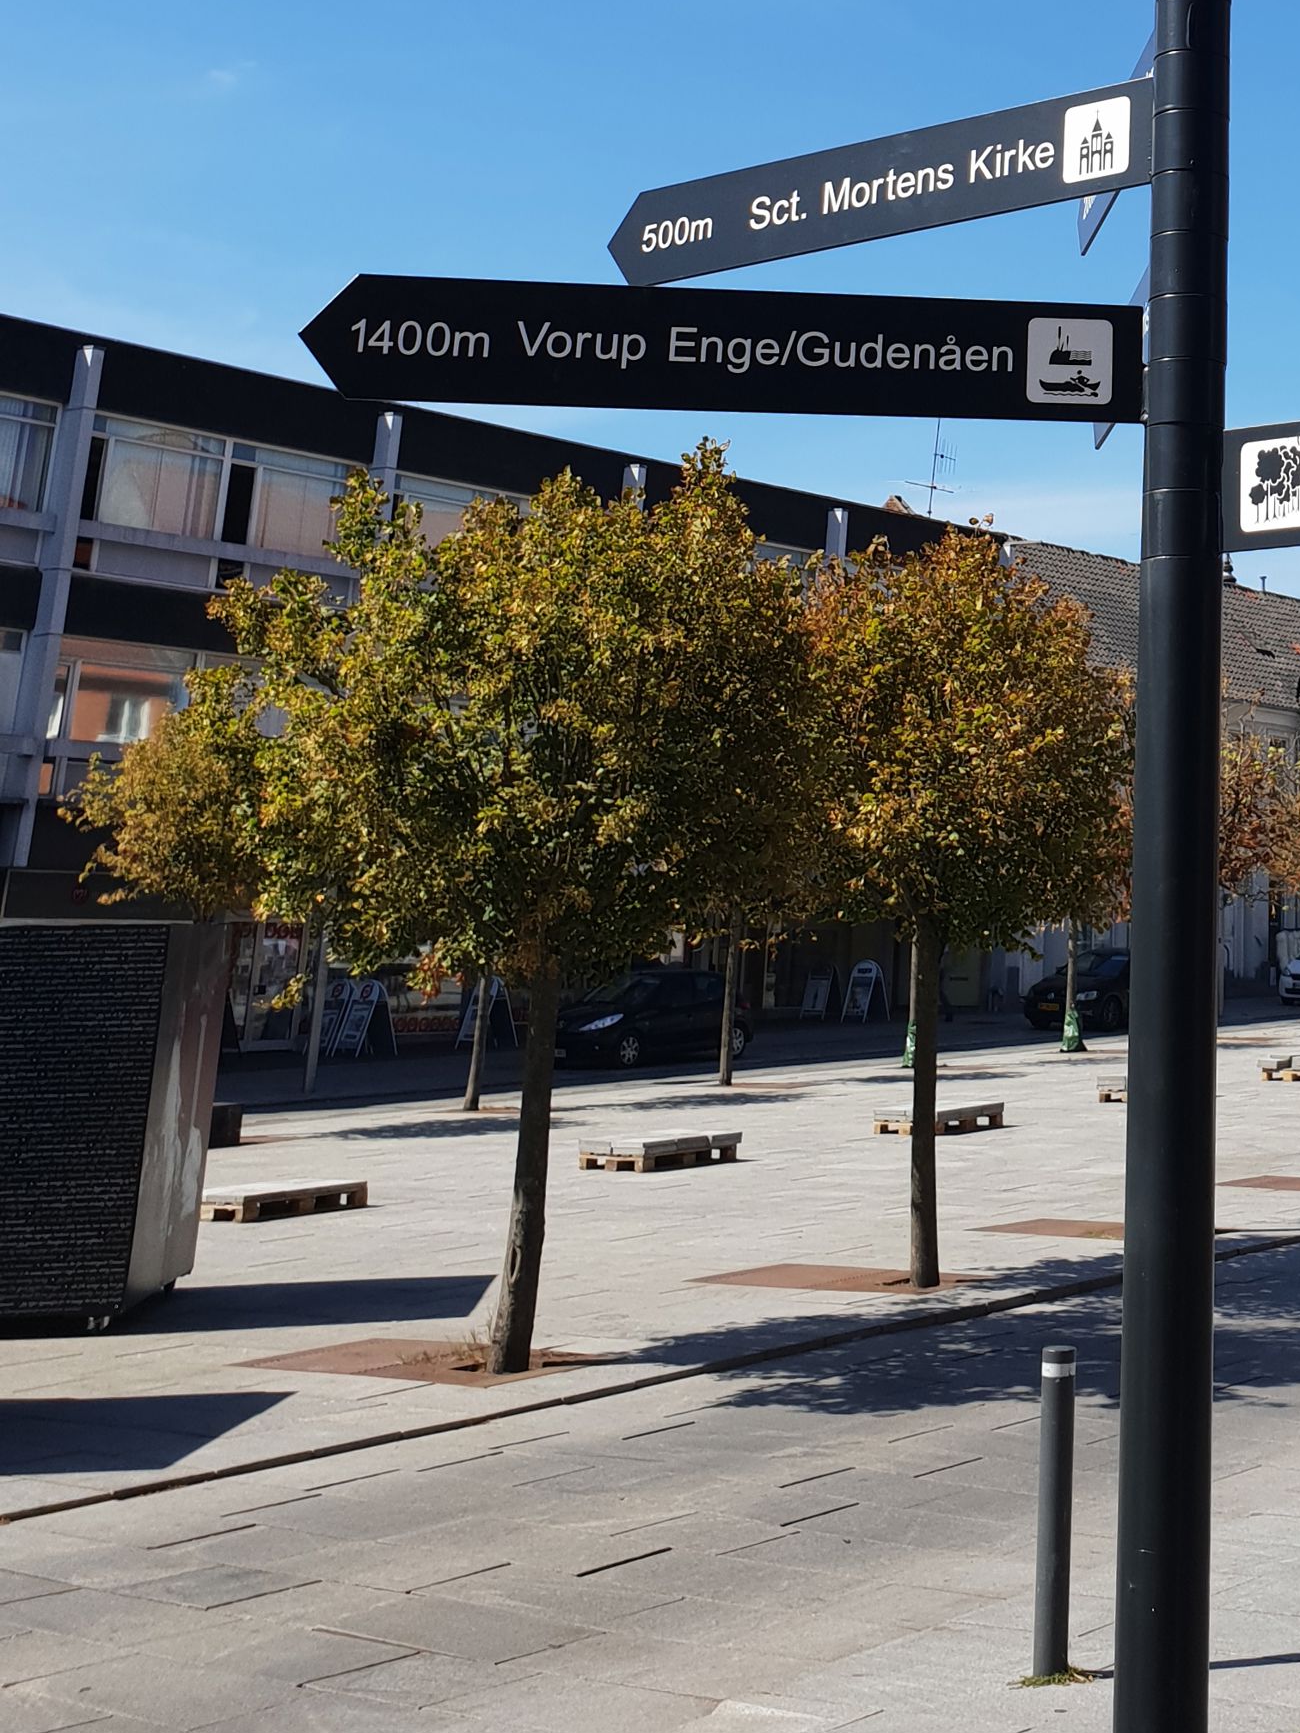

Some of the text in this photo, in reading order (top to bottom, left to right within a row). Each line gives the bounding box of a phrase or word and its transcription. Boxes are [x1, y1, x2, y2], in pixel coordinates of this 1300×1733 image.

[641, 138, 1055, 253] 500m Sct. Mortens Kirke
[351, 318, 1013, 374] 1400m Vorup Enge/Gudenåen
